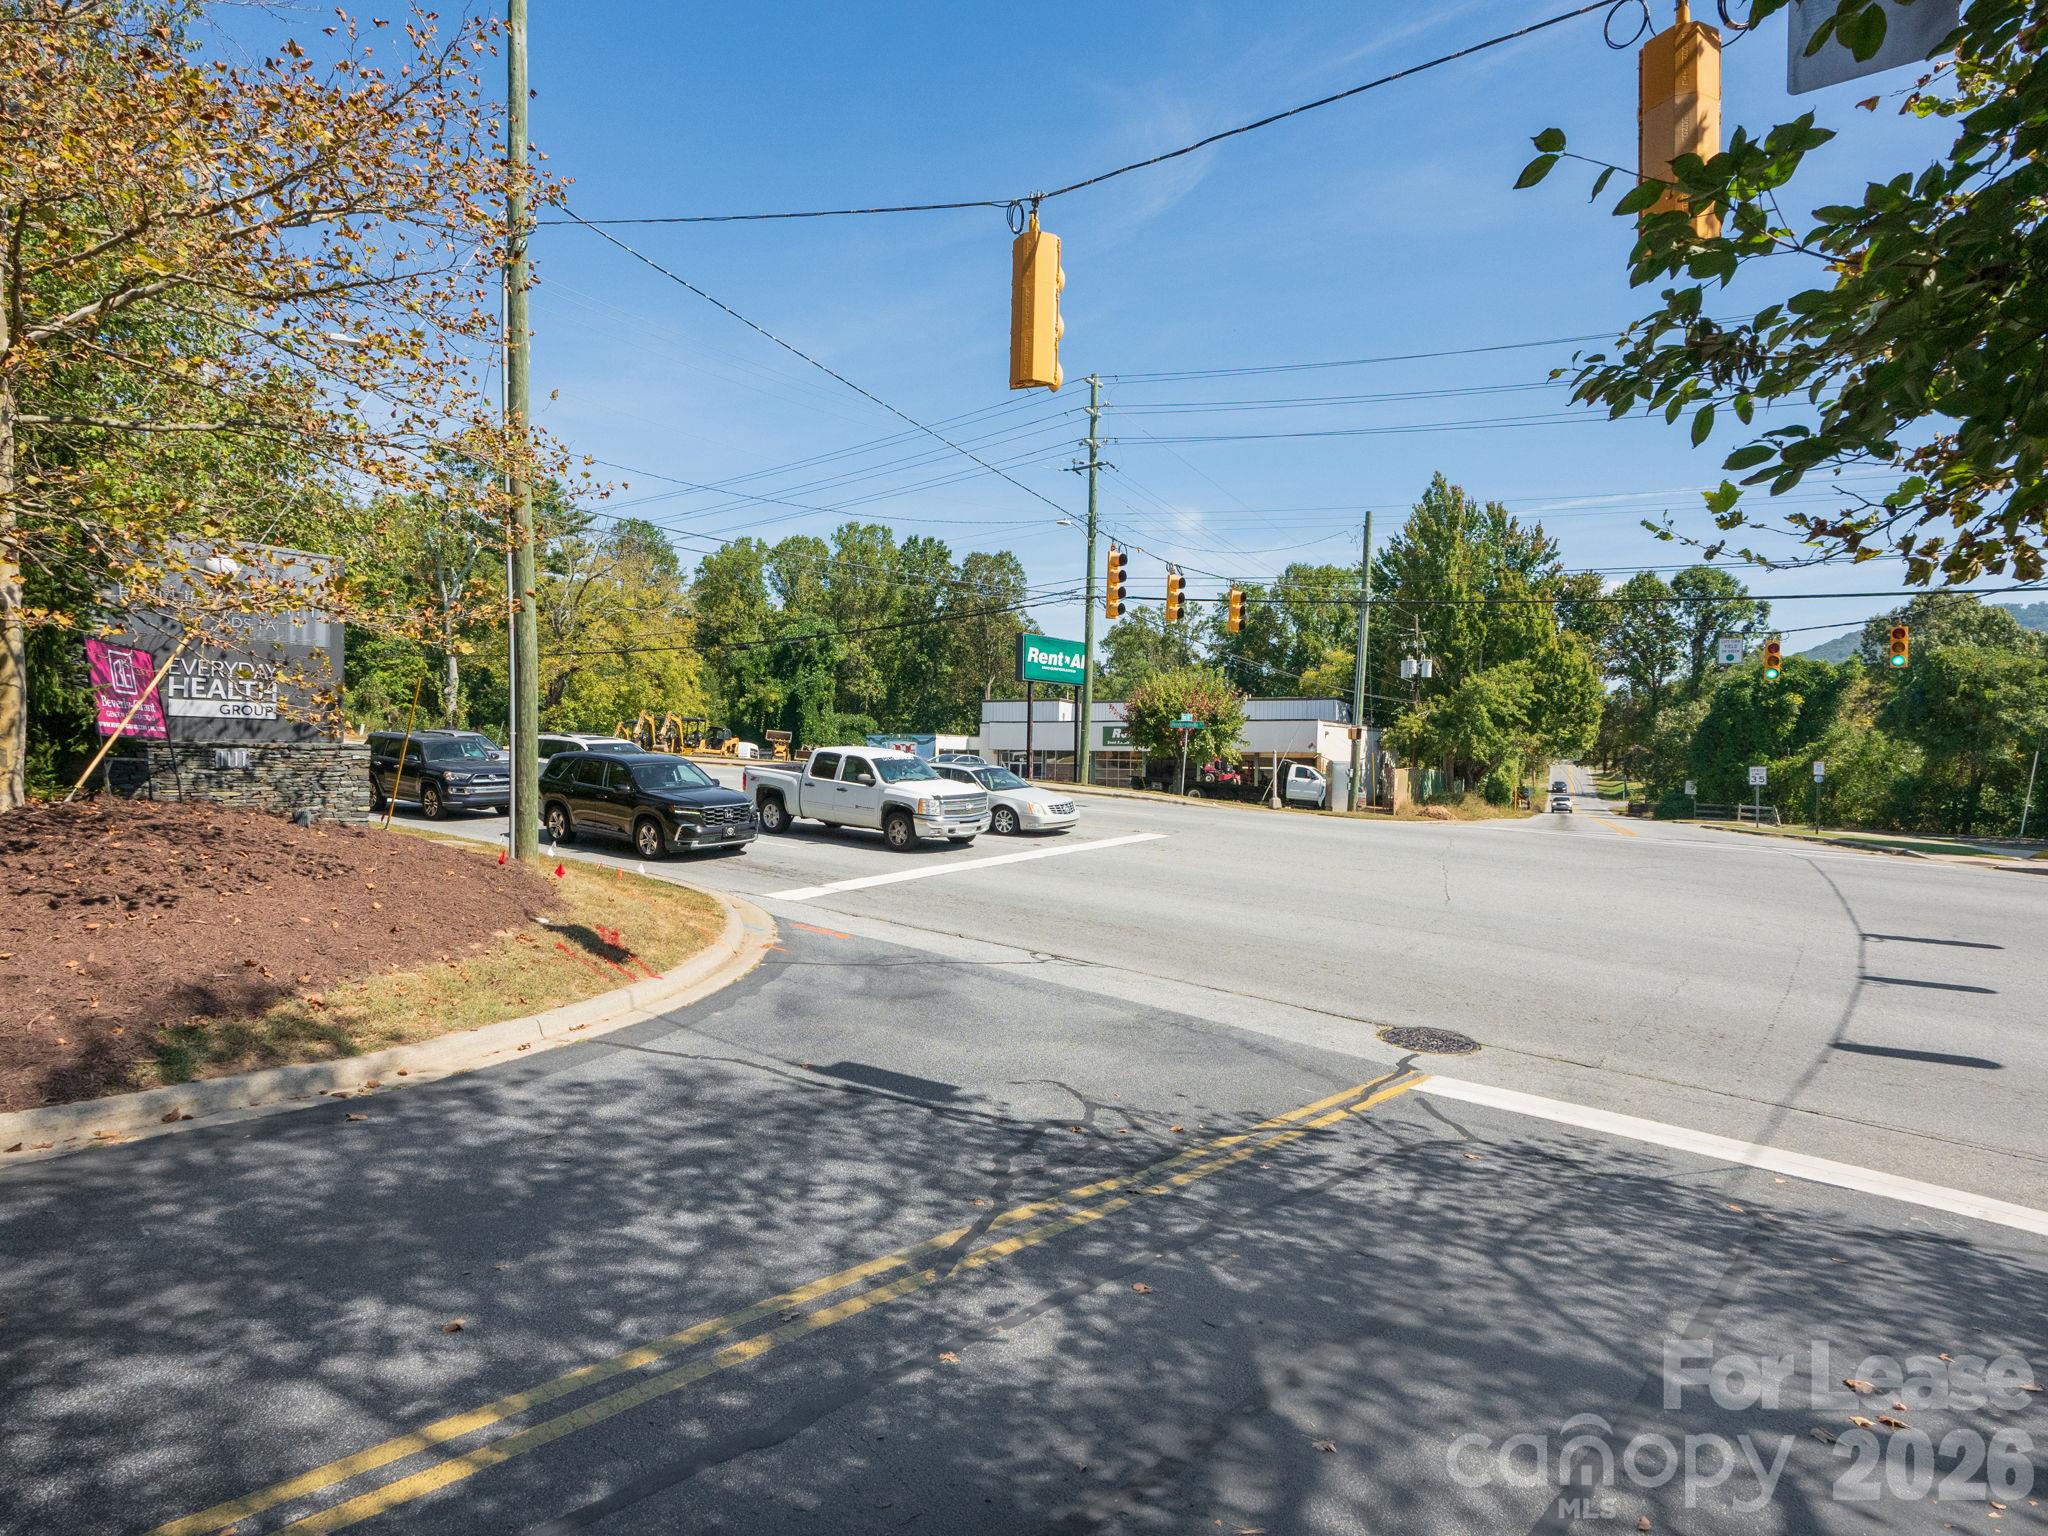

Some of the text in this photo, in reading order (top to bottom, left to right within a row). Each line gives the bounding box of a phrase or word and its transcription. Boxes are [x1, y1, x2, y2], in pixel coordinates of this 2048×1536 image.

[168, 657, 277, 680] EVERYDAY
[168, 676, 277, 702] HEALTH
[219, 704, 274, 717] GROUP
[1750, 775, 1765, 783] 35
